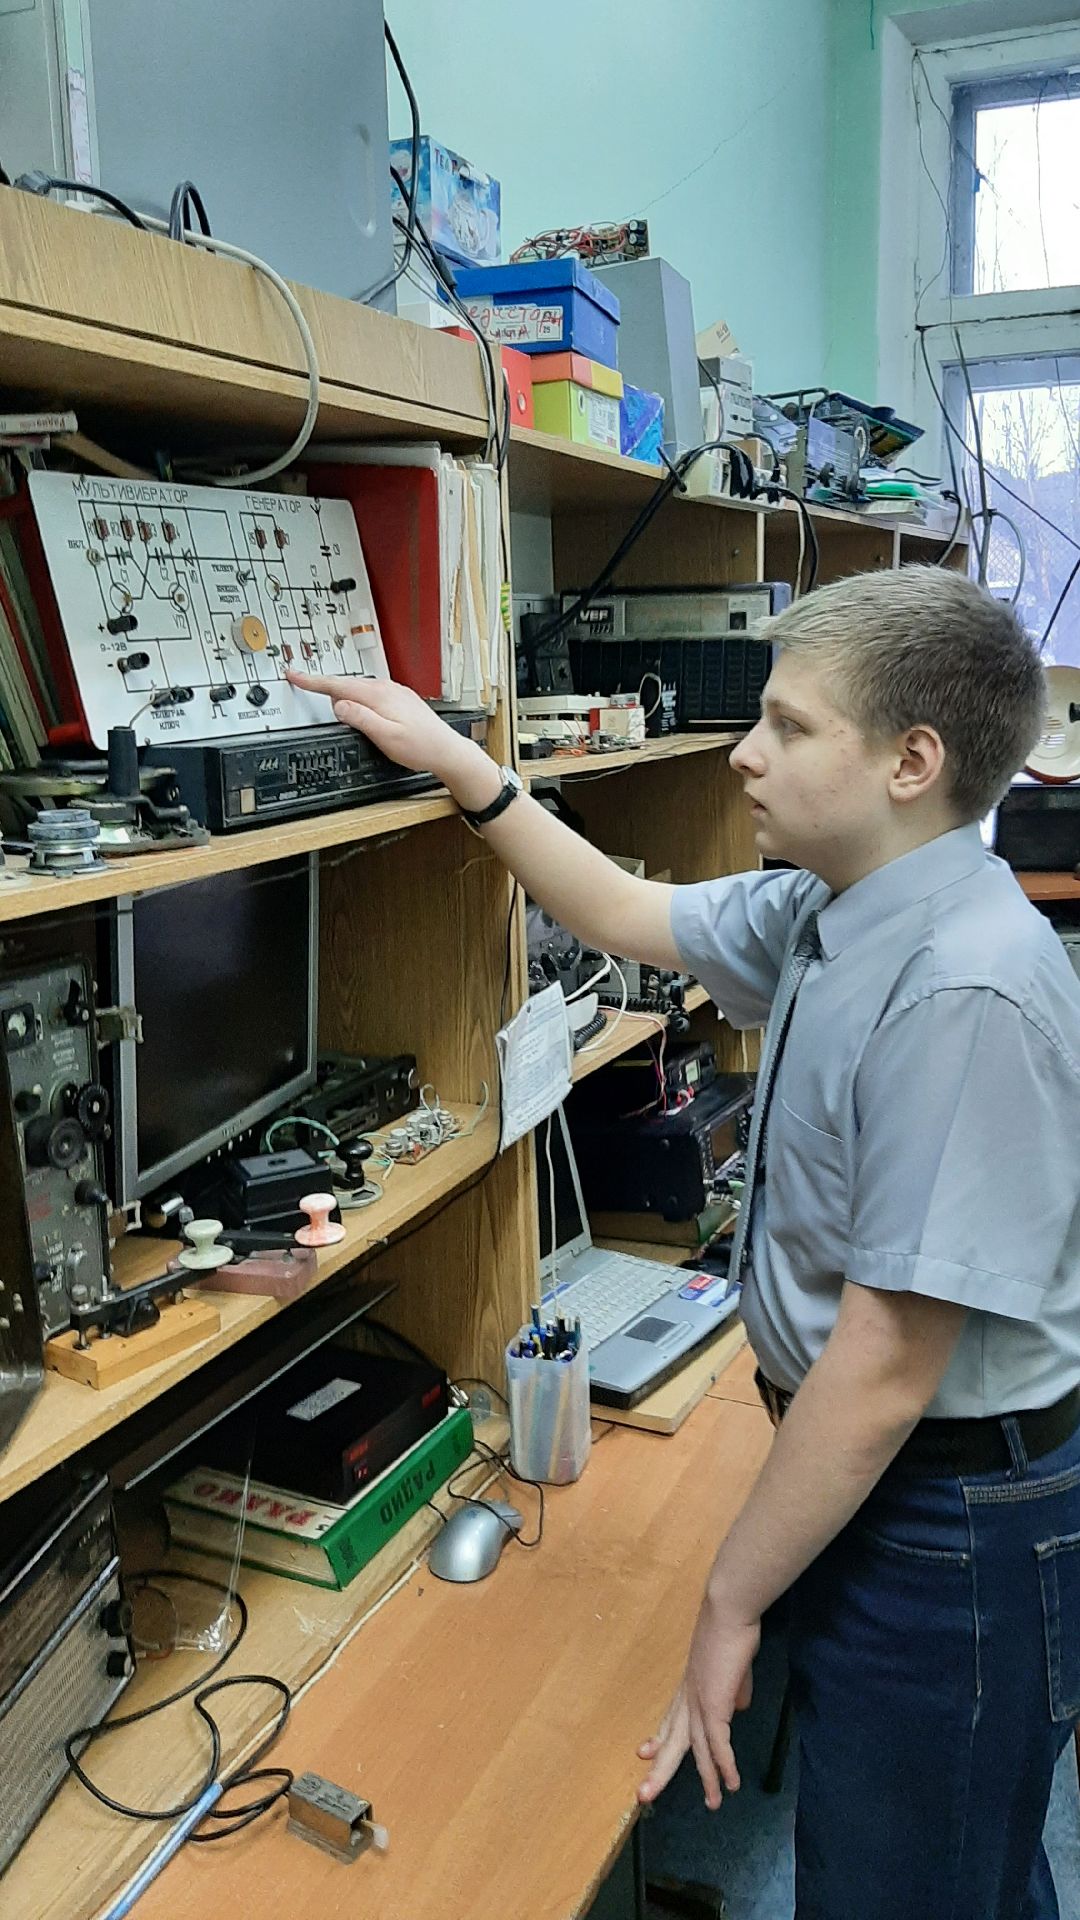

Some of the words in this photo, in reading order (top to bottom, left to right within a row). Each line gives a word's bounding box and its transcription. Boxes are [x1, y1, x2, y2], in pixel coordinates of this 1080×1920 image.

[72, 480, 189, 503] МУЛЬТИВИБРАТОР
[245, 495, 302, 513] ГЕНЕРАТОР
[579, 609, 609, 622] VEF
[380, 1459, 436, 1526] РАДИО
[194, 1481, 319, 1528] РАДИО
